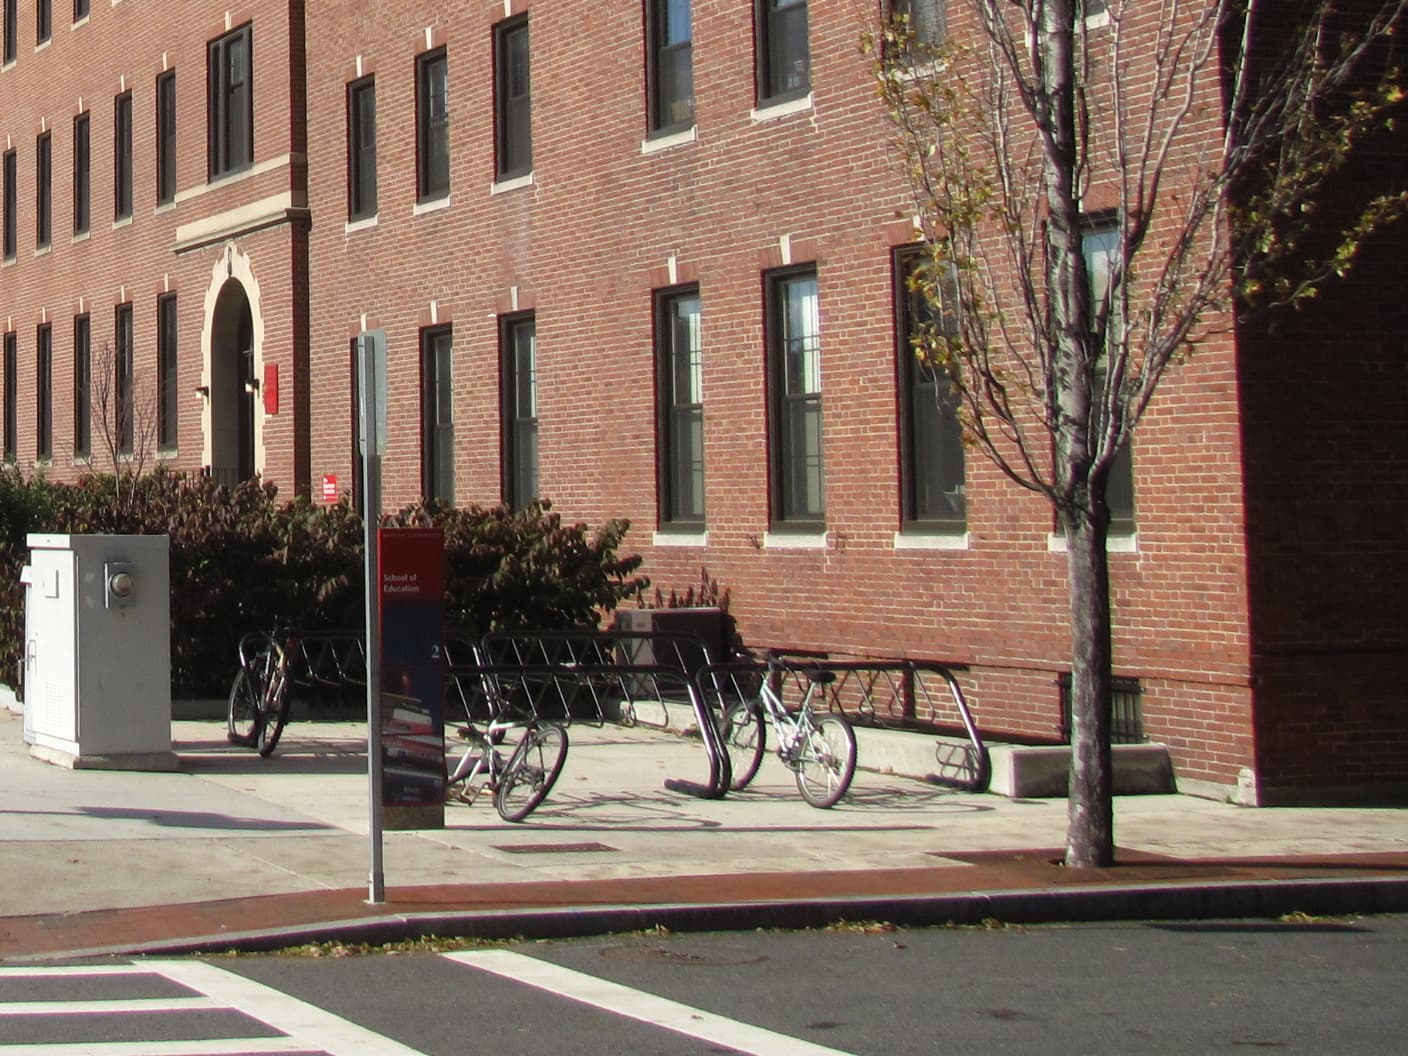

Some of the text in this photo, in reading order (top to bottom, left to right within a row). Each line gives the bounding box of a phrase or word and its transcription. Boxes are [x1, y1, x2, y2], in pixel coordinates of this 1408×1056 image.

[383, 573, 408, 582] School
[383, 585, 420, 593] Education
[431, 644, 440, 659] 2
